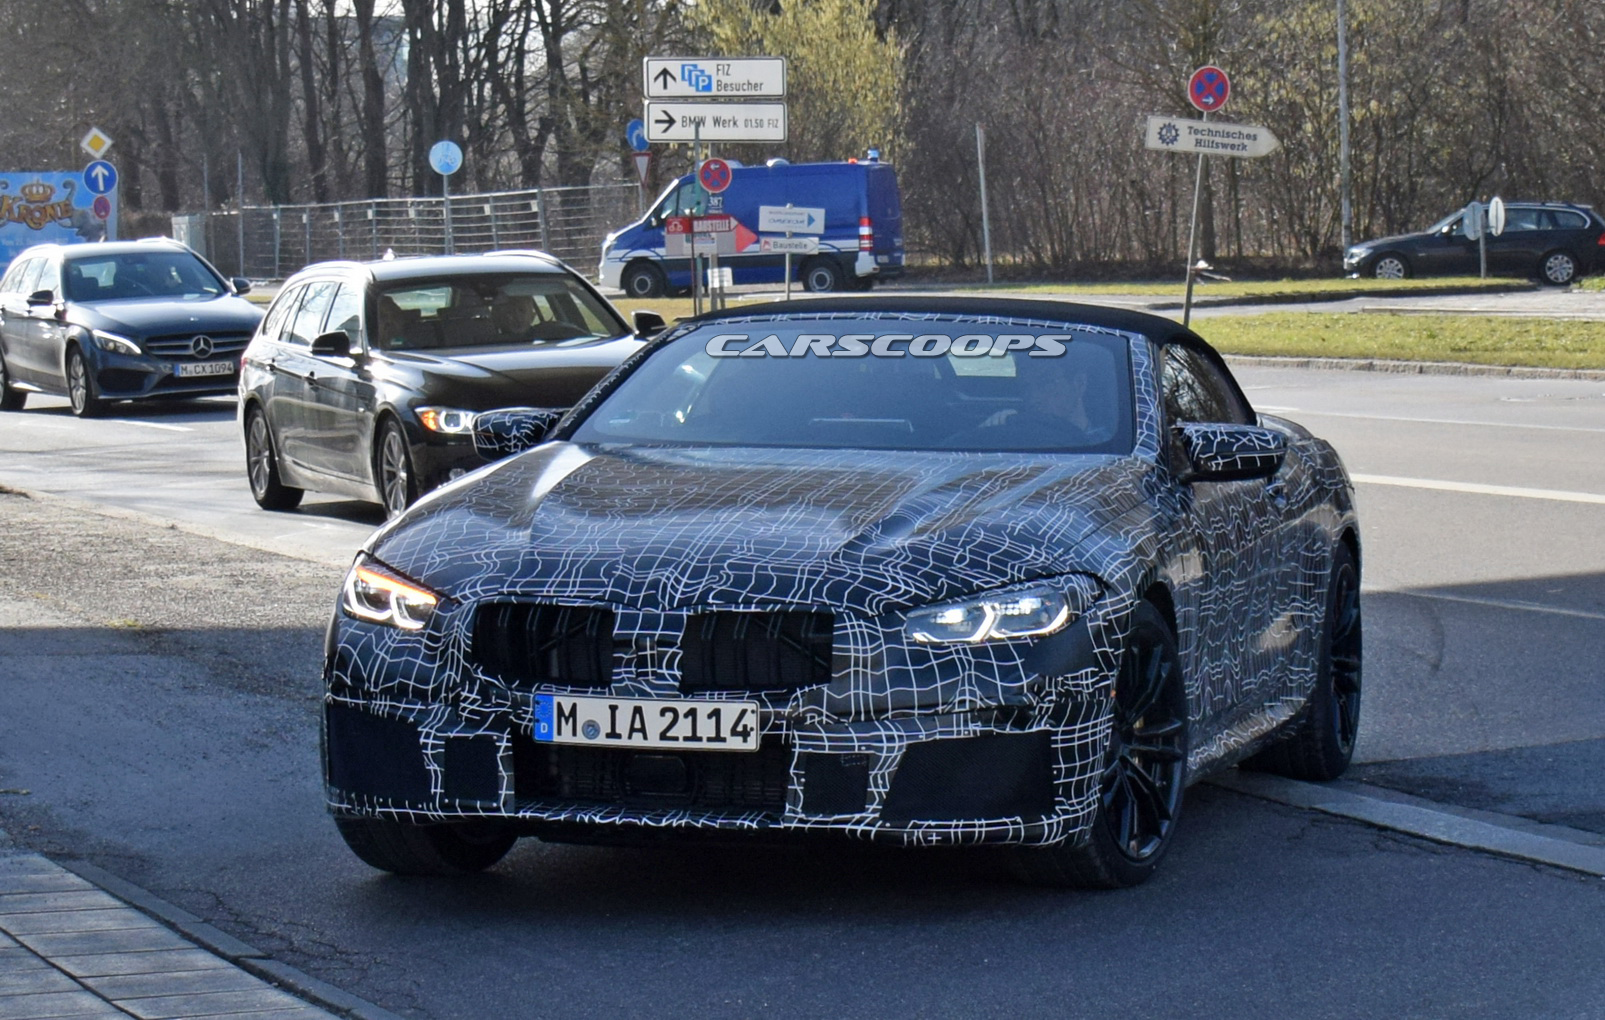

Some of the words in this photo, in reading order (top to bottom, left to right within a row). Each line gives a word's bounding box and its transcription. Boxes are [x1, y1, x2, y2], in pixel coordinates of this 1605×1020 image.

[716, 64, 731, 76] FIZ
[716, 79, 764, 92] Besucher
[681, 115, 706, 128] BMW
[712, 115, 739, 128] Werk
[767, 118, 779, 128] FIZ
[1187, 126, 1258, 141] Technisches
[1195, 138, 1248, 151] Hilfswerk
[556, 701, 577, 737] M
[659, 706, 751, 743] 2114
